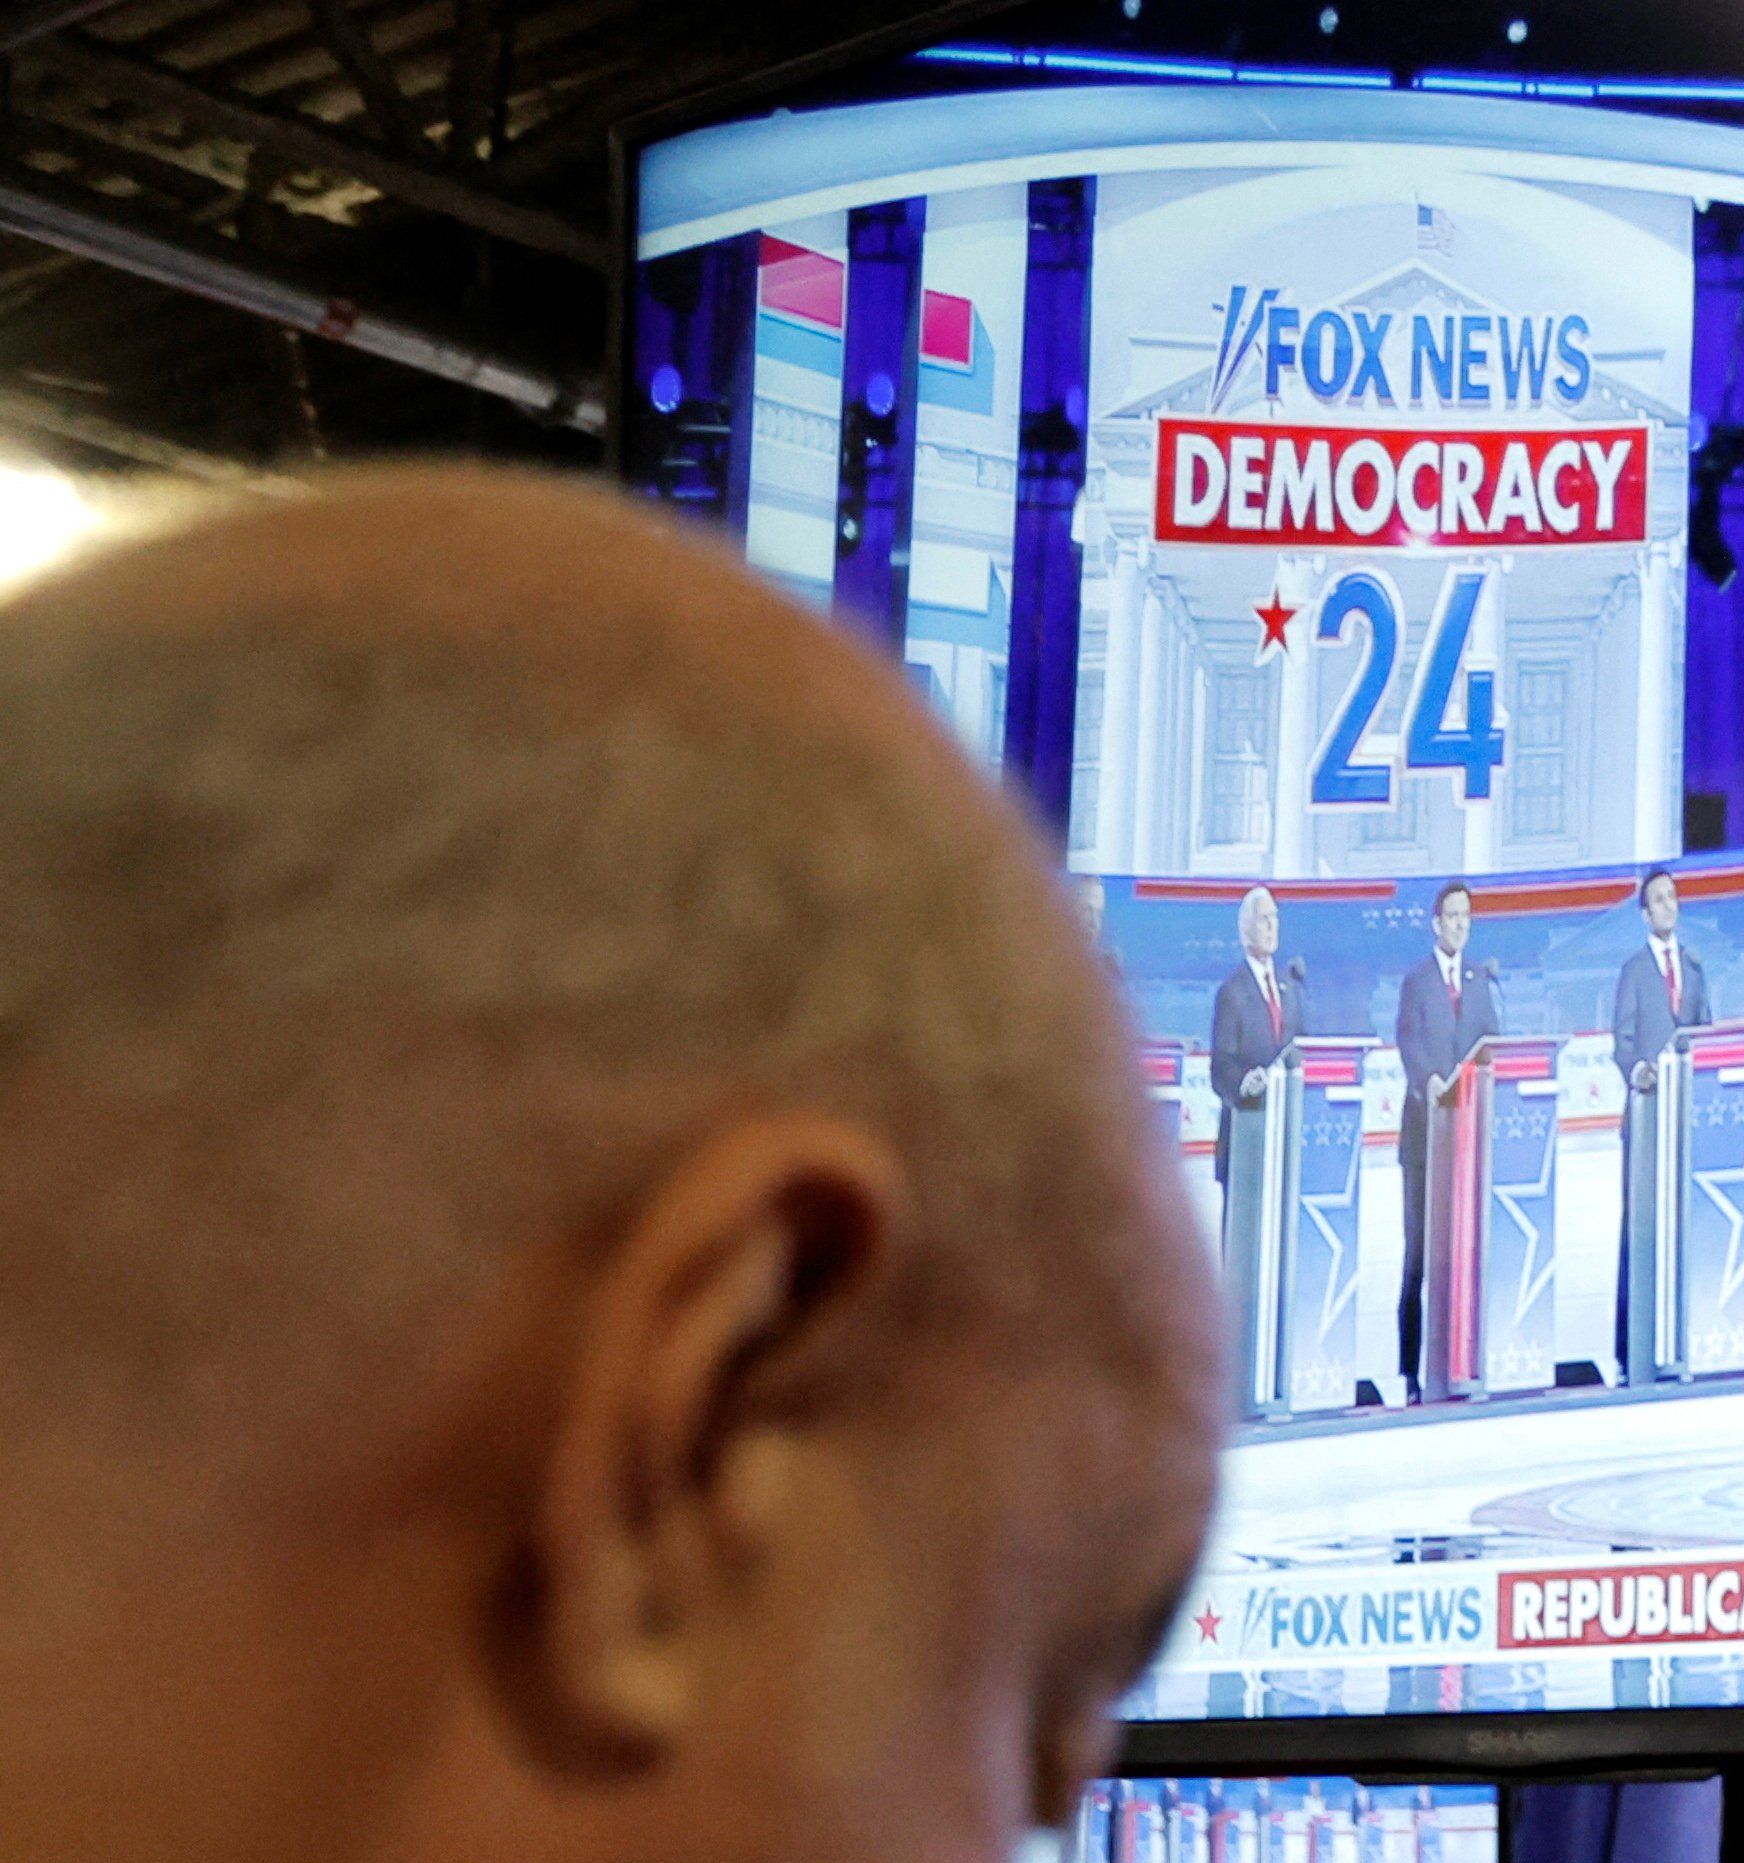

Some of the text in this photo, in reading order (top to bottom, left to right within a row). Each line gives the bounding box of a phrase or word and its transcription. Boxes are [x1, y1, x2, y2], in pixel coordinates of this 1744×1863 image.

[1265, 307, 1592, 408] FOX NEWS
[1173, 433, 1632, 536] DEMOCRACY
[1310, 569, 1506, 806] 24
[1270, 1592, 1347, 1648] FOX
[1360, 1584, 1483, 1646] NEWS
